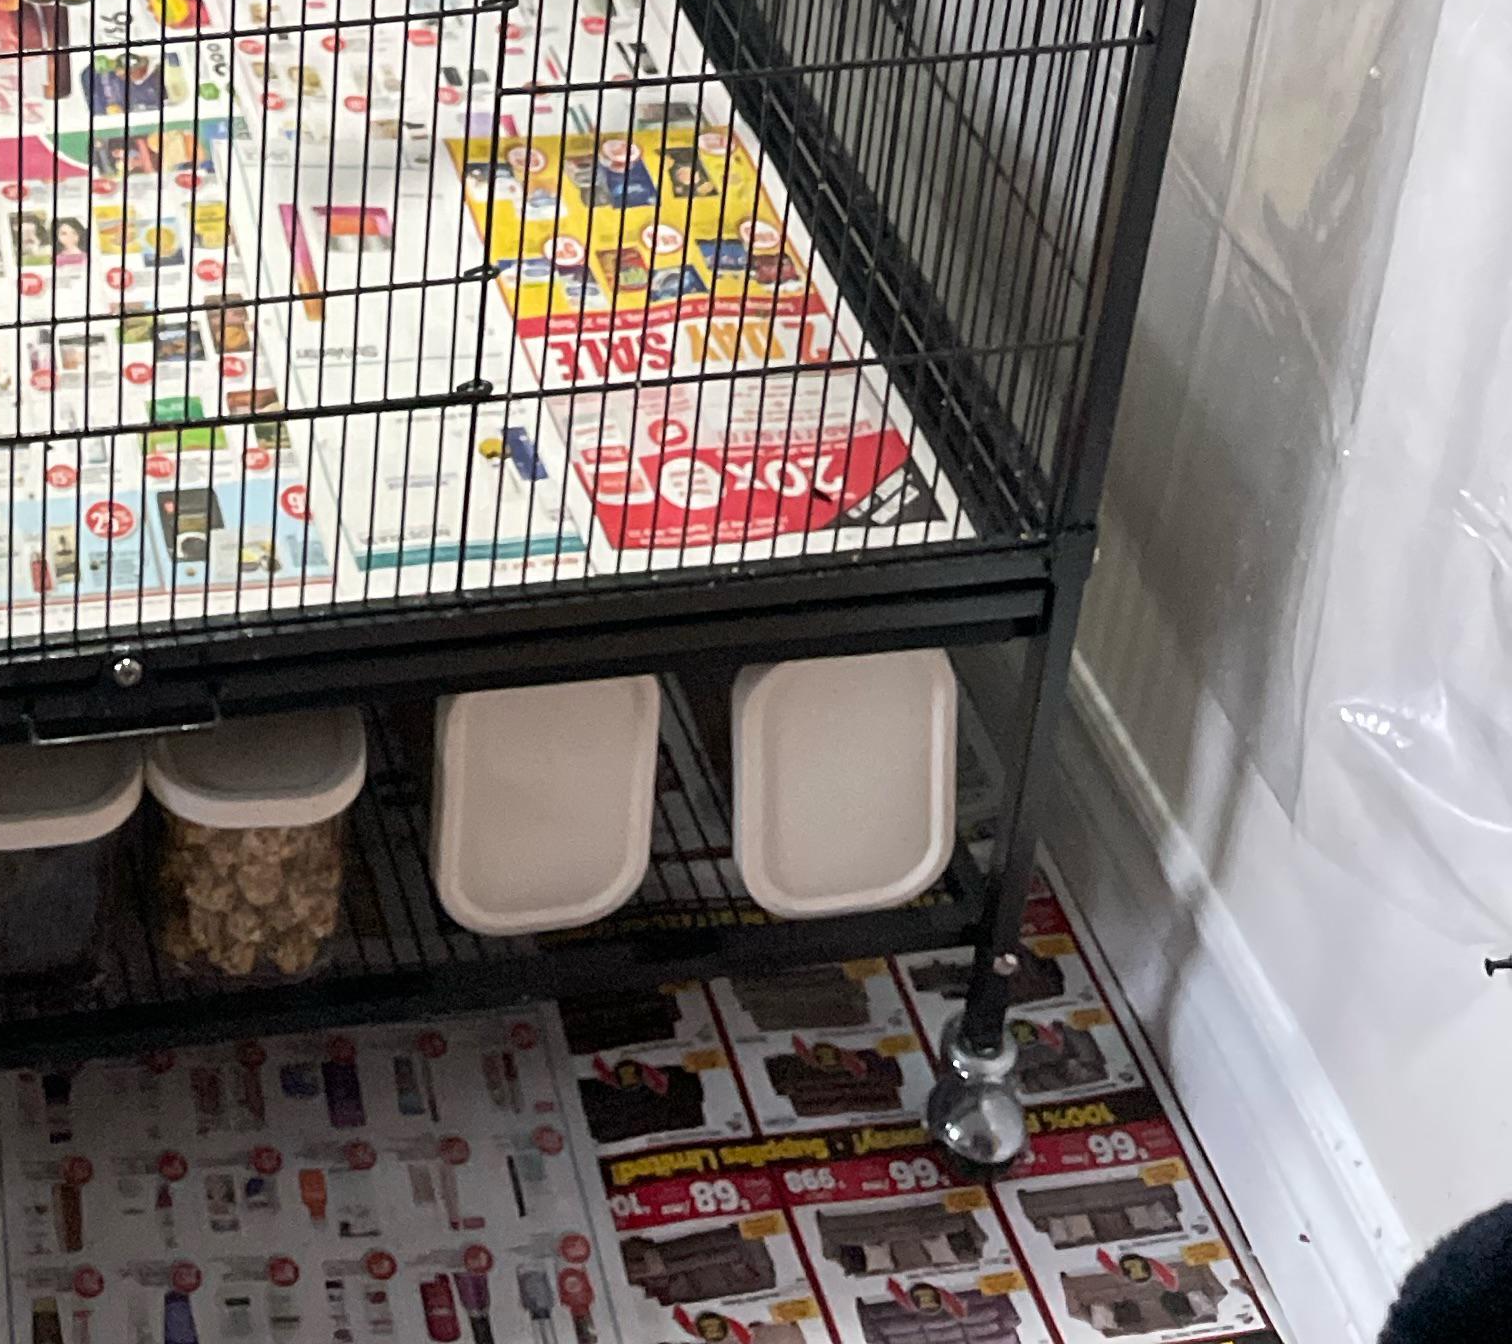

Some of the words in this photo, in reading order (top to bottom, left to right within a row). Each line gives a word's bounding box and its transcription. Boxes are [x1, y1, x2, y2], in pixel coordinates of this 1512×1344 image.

[549, 332, 671, 381] SALE
[611, 1148, 718, 1185] Limited!
[719, 1138, 829, 1168] Supplies
